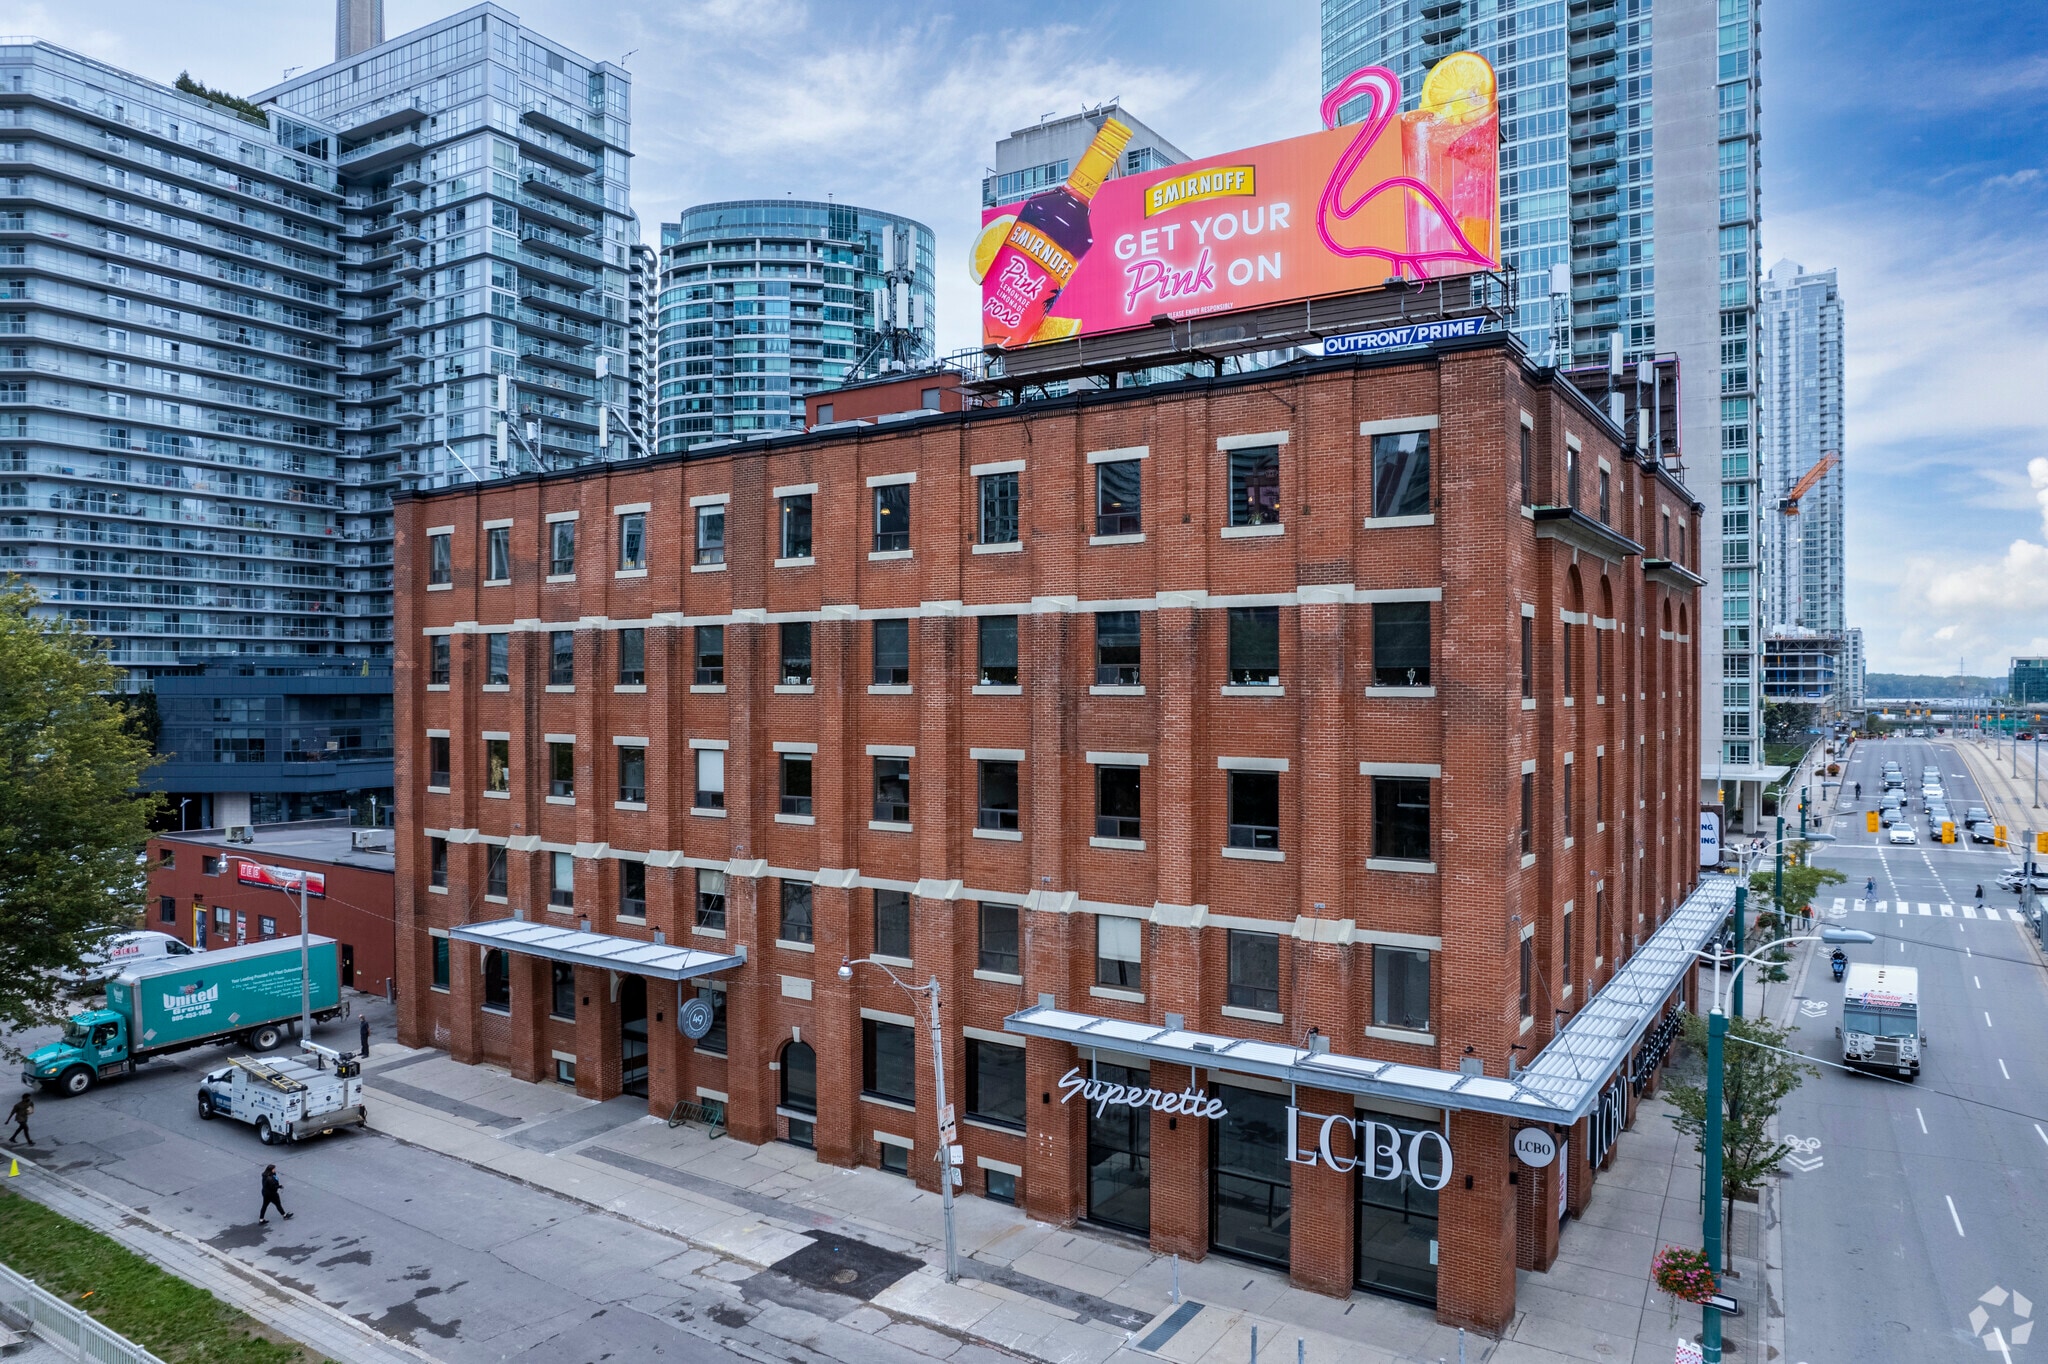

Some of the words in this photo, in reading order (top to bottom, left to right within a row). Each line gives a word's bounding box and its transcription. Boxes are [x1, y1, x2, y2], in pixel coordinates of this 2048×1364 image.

[1153, 171, 1246, 208] SMIRNOFF
[1114, 223, 1181, 260] GET
[1190, 202, 1291, 245] YOUR
[1010, 226, 1073, 280] SMIRNOFF
[1000, 255, 1046, 300] Pink
[1125, 248, 1215, 313] Pink
[1227, 251, 1282, 286] ON
[996, 288, 1026, 315] LIMONADE
[1000, 281, 1030, 308] LEMONADE
[1200, 302, 1234, 313] RESPONSIBLY
[163, 982, 218, 1009] United
[172, 1003, 211, 1015] Group
[692, 1013, 703, 1025] 49
[1058, 1066, 1229, 1119] Superette
[1285, 1105, 1454, 1191] LCBO
[1518, 1139, 1551, 1156] LCBO
